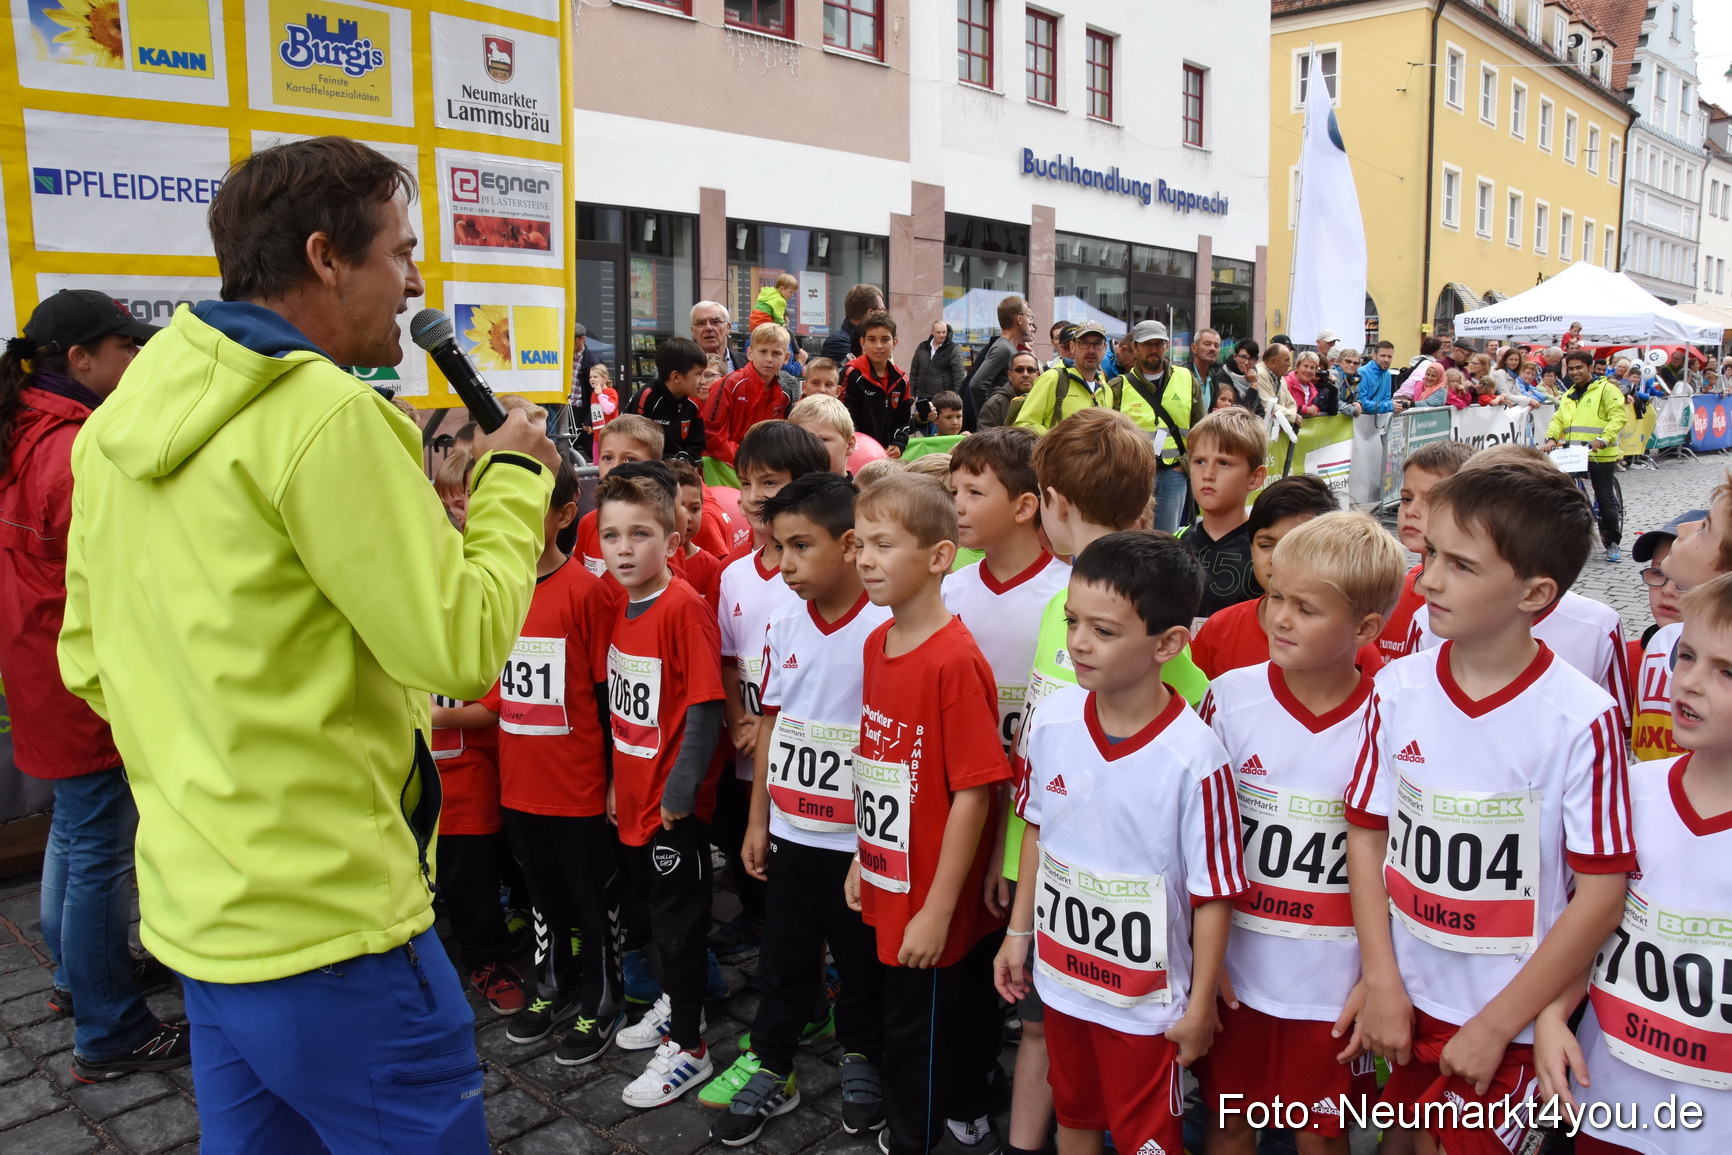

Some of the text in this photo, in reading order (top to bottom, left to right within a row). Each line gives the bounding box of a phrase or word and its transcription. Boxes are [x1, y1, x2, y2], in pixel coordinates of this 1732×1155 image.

[138, 46, 207, 72] KANN
[280, 23, 384, 78] Burgis
[318, 74, 349, 87] Feinste
[286, 82, 380, 103] Kartoffelspezialitäten
[461, 84, 538, 110] Neumarkter
[447, 99, 550, 134] Lammsbräu
[1021, 147, 1152, 205] Buchhandlung
[481, 195, 550, 211] PFLASTERSTEINE
[1157, 178, 1229, 216] Rupprecht
[1490, 314, 1563, 324] ConnectedDrive
[521, 350, 558, 365] KANN
[610, 668, 650, 721] 7068
[614, 720, 629, 740] Paul
[1397, 753, 1426, 764] adidas
[1240, 767, 1267, 776] adidas
[1045, 784, 1067, 796] adidas
[798, 798, 834, 818] Emre
[1433, 795, 1524, 817] BOCK
[1432, 814, 1460, 824] inspired
[1241, 814, 1348, 885] 7042
[1390, 855, 1395, 865] 4
[1398, 809, 1523, 892] 7004
[1078, 872, 1151, 897] BOCK
[1523, 886, 1532, 897] K
[1250, 891, 1315, 919] Jonas
[1413, 894, 1477, 931] Lukas
[1038, 921, 1044, 931] 4
[1044, 881, 1152, 964] 7020
[1656, 931, 1687, 944] inspired
[1688, 937, 1699, 945] by
[1066, 953, 1122, 989] Ruben
[1155, 960, 1163, 970] K
[1625, 1012, 1707, 1062] Simon
